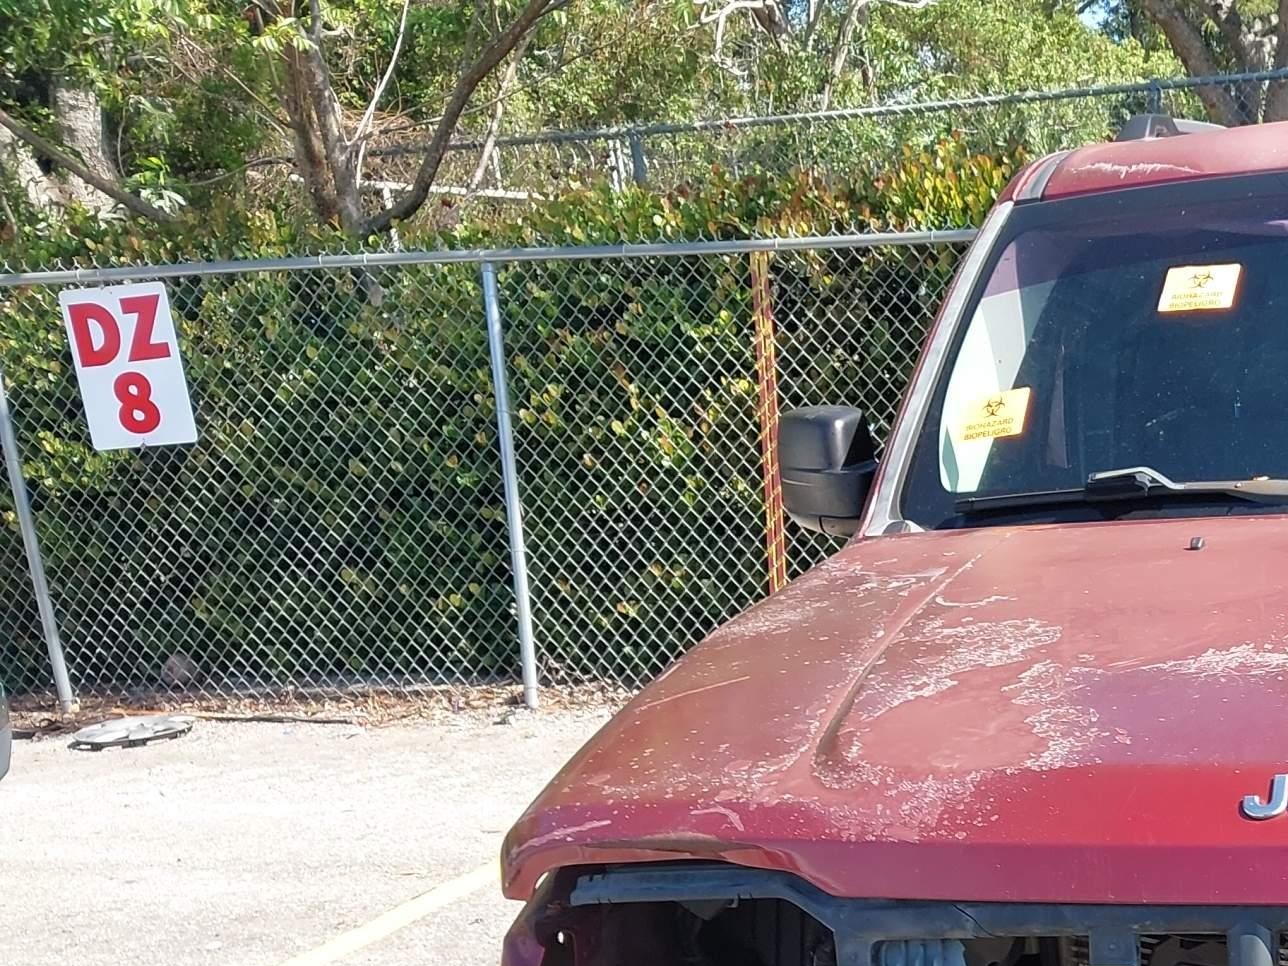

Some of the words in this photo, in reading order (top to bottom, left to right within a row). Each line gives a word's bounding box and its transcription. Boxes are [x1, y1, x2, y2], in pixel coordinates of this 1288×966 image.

[68, 294, 171, 368] DZ
[113, 371, 161, 434] 8
[963, 427, 1013, 441] BIOPELIGRO
[965, 417, 1014, 432] BIOHAZARD
